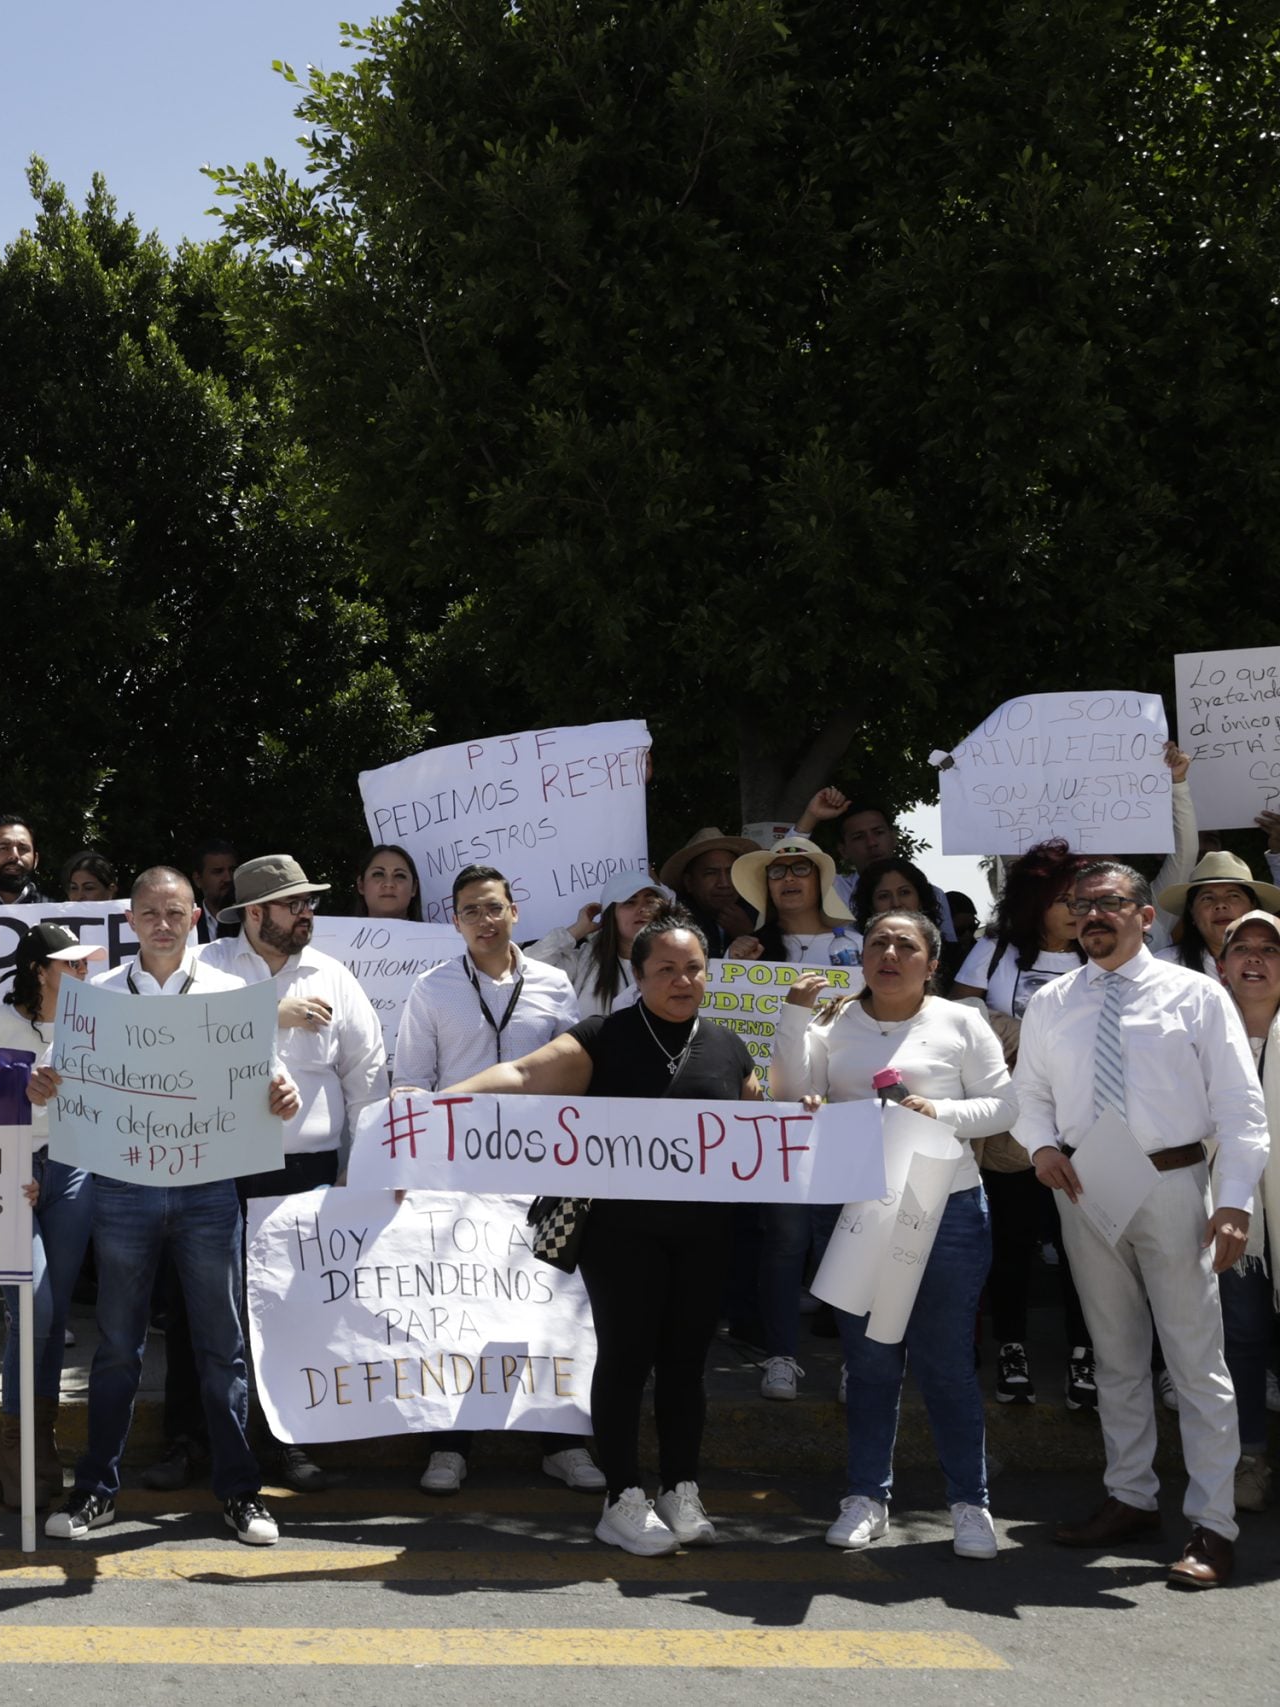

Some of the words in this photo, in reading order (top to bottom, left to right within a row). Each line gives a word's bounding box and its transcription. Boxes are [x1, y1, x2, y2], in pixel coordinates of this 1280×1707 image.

[1236, 666, 1279, 688] que
[1048, 697, 1142, 724] SON
[1190, 713, 1212, 736] al
[951, 733, 1168, 767] PRIVILEGIOS
[972, 784, 1027, 805] SON
[1039, 773, 1171, 803] NUESTROS
[374, 779, 520, 844] PEDIMOS
[990, 800, 1152, 828] DERECHOS
[426, 817, 558, 878] NUESTROS
[350, 927, 391, 950] NO
[63, 991, 96, 1051] Hoy
[126, 1023, 175, 1049] nos
[197, 1003, 254, 1044] toca
[228, 1059, 270, 1099] para
[56, 1095, 102, 1124] poder
[116, 1105, 236, 1144] defenderte
[381, 1097, 814, 1182] #TodosSomosPJF
[122, 1144, 208, 1175] #PJF
[295, 1211, 368, 1271] HOY
[415, 1209, 533, 1257] TOCA
[320, 1261, 554, 1304] DEFENDERNOS
[375, 1306, 481, 1345] PARA
[300, 1353, 579, 1410] DEFENDERTE
